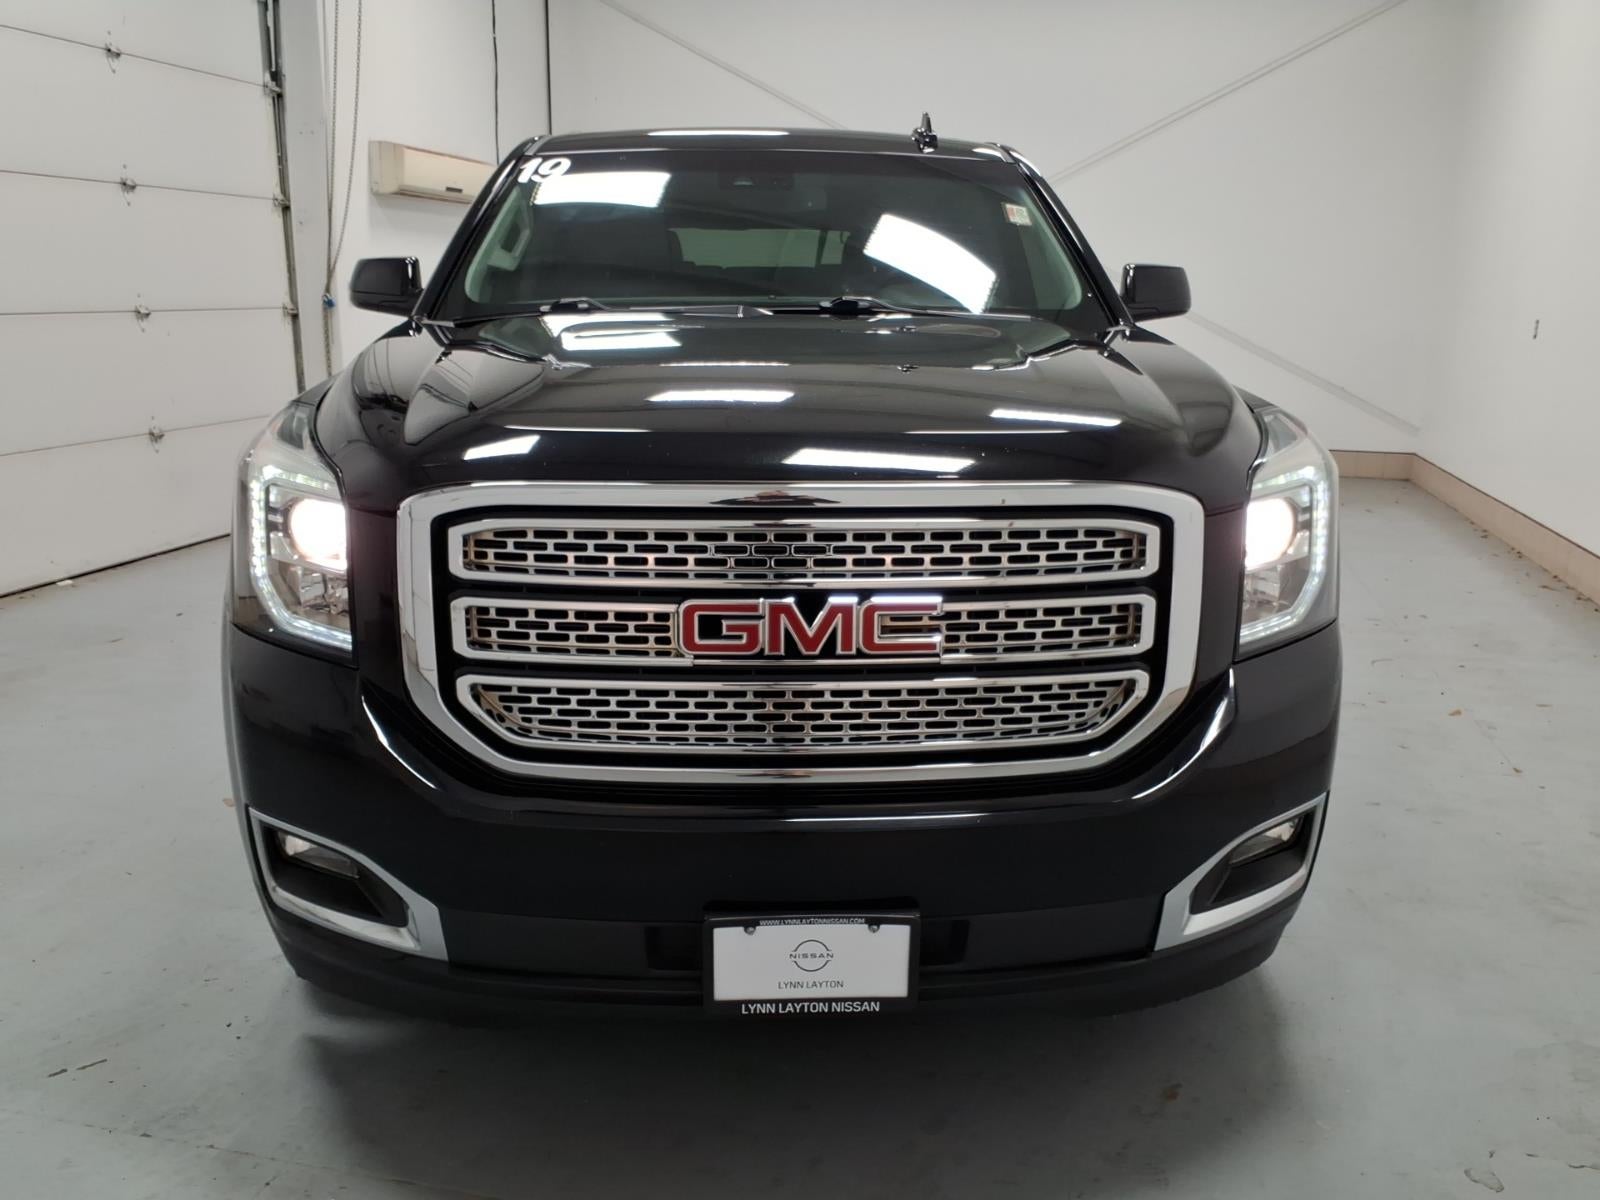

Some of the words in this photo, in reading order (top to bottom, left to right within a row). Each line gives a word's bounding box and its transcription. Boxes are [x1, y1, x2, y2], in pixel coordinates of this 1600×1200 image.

[517, 157, 571, 183] 19
[678, 596, 943, 656] GMC
[759, 918, 865, 926] WWW.LYNNLAYTONNISSAN.COM
[789, 952, 834, 960] NISSAN
[778, 981, 804, 990] LYNN
[806, 980, 844, 989] LAYTON
[741, 1003, 776, 1014] LYNN
[779, 1002, 829, 1014] LAYTON
[831, 1001, 880, 1013] NISSAN
